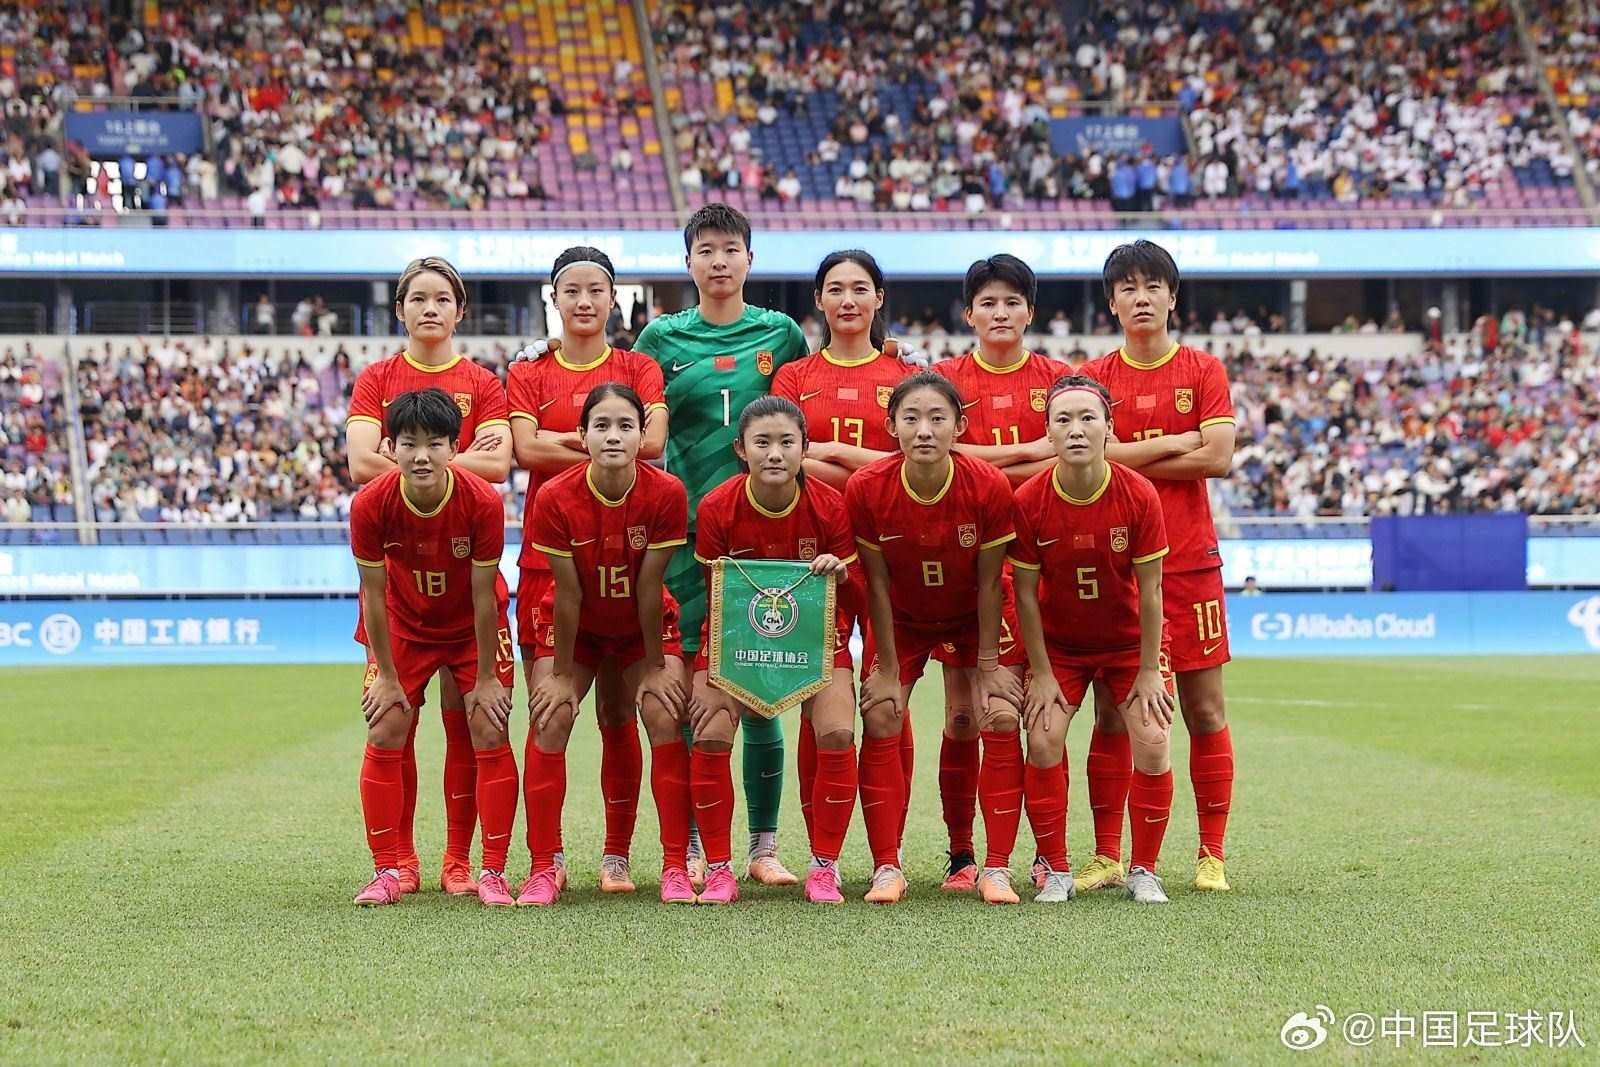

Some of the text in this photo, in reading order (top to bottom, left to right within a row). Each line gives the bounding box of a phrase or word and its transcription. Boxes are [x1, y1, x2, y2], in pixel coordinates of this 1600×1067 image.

[720, 388, 730, 426] 1
[830, 417, 864, 448] 13
[412, 570, 447, 597] 18
[597, 564, 631, 598] 15
[922, 561, 944, 586] 8
[1077, 567, 1098, 600] 5
[94, 617, 260, 645] 中国工商银行
[1193, 600, 1222, 641] 10
[1295, 613, 1436, 638] Alibaba Cloud
[735, 648, 808, 664] 中国足球协会
